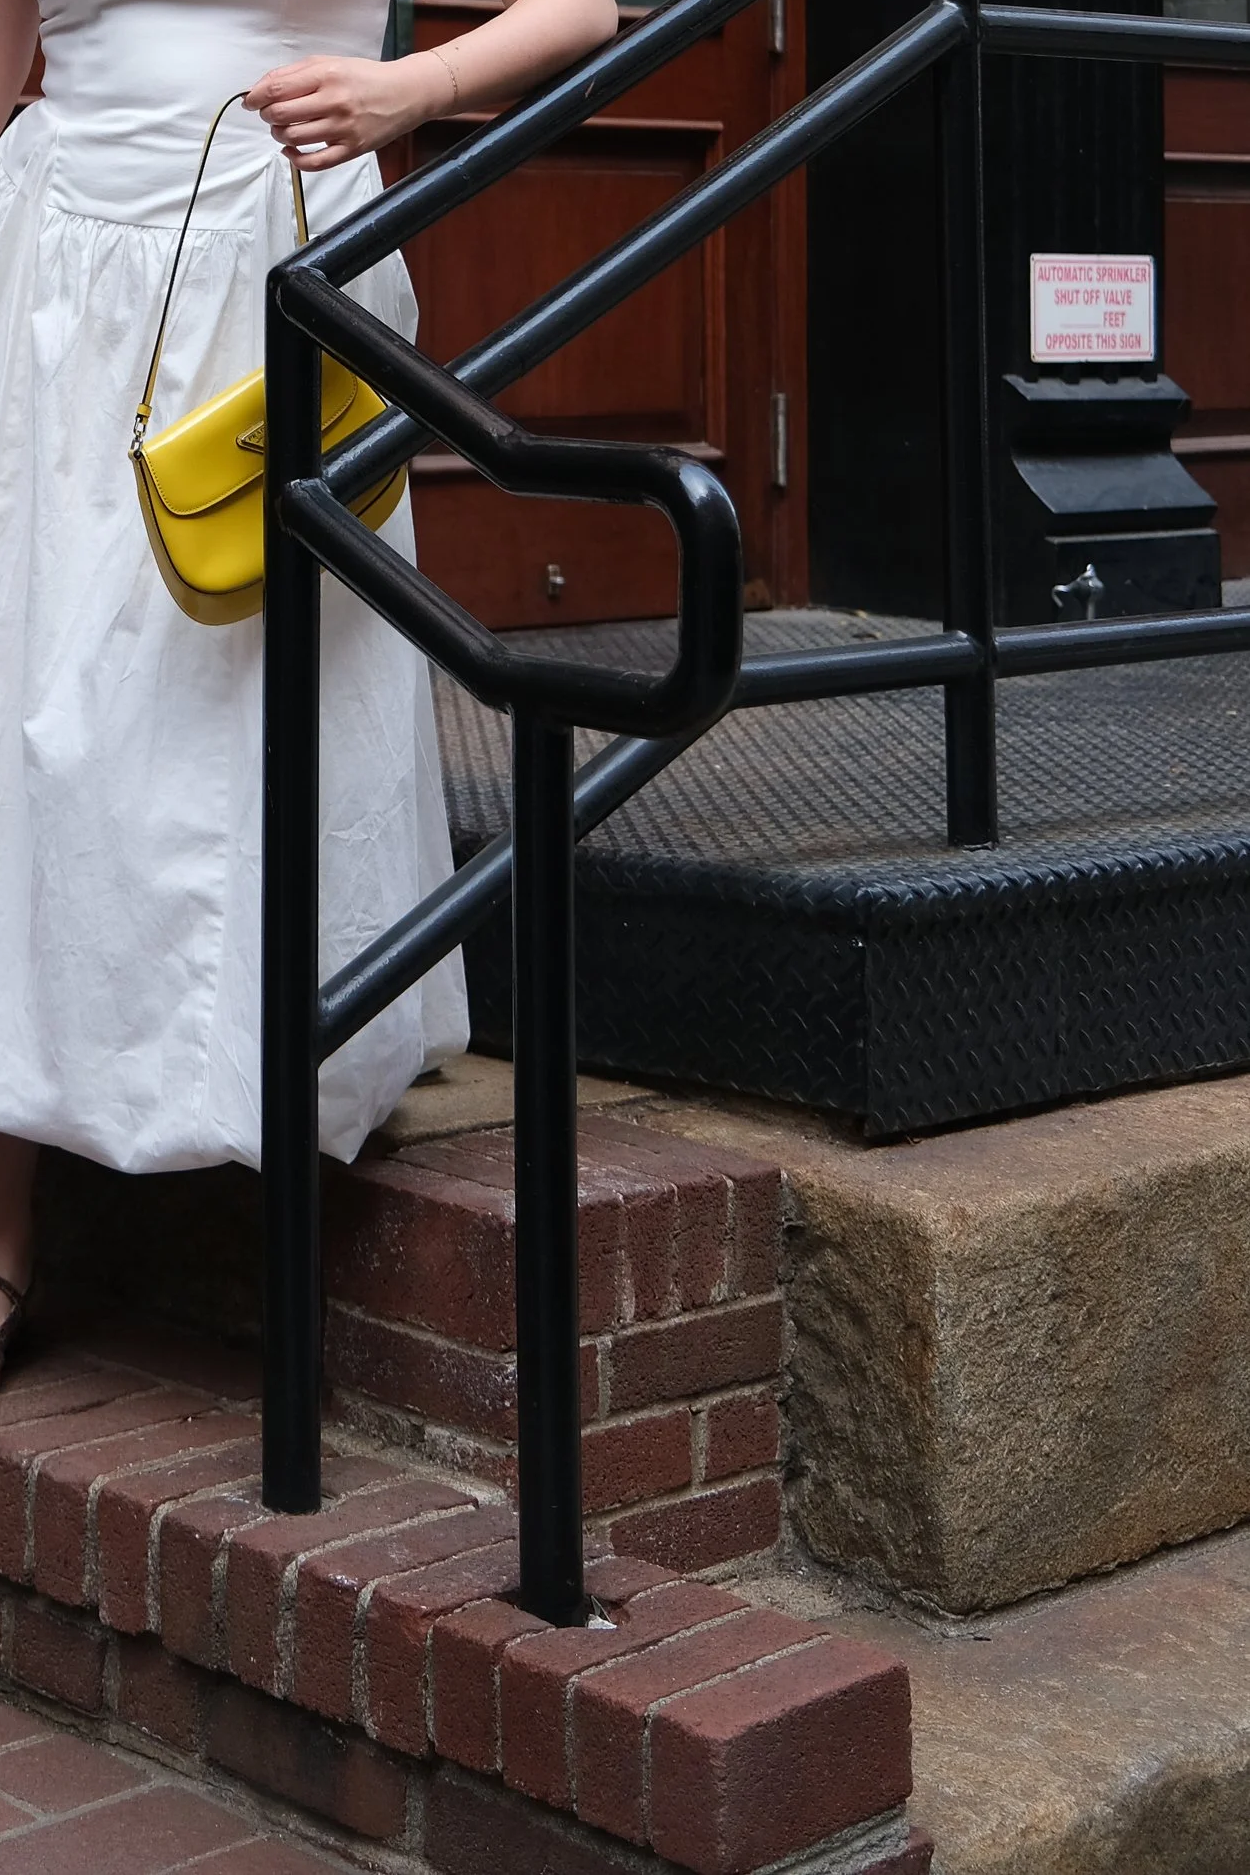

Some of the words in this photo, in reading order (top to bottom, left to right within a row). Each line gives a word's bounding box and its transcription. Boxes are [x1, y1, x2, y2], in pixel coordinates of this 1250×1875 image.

[1038, 266, 1093, 282] AUTOMATIC
[1096, 267, 1147, 283] SPRINKLER
[1054, 289, 1080, 305] SHUT
[1083, 290, 1100, 305] OFF
[1103, 290, 1132, 305] VALVE
[1103, 311, 1126, 327] FEET
[1046, 333, 1092, 349] OPPOSITE
[1095, 334, 1116, 349] THIS
[1120, 334, 1141, 349] SIGN
